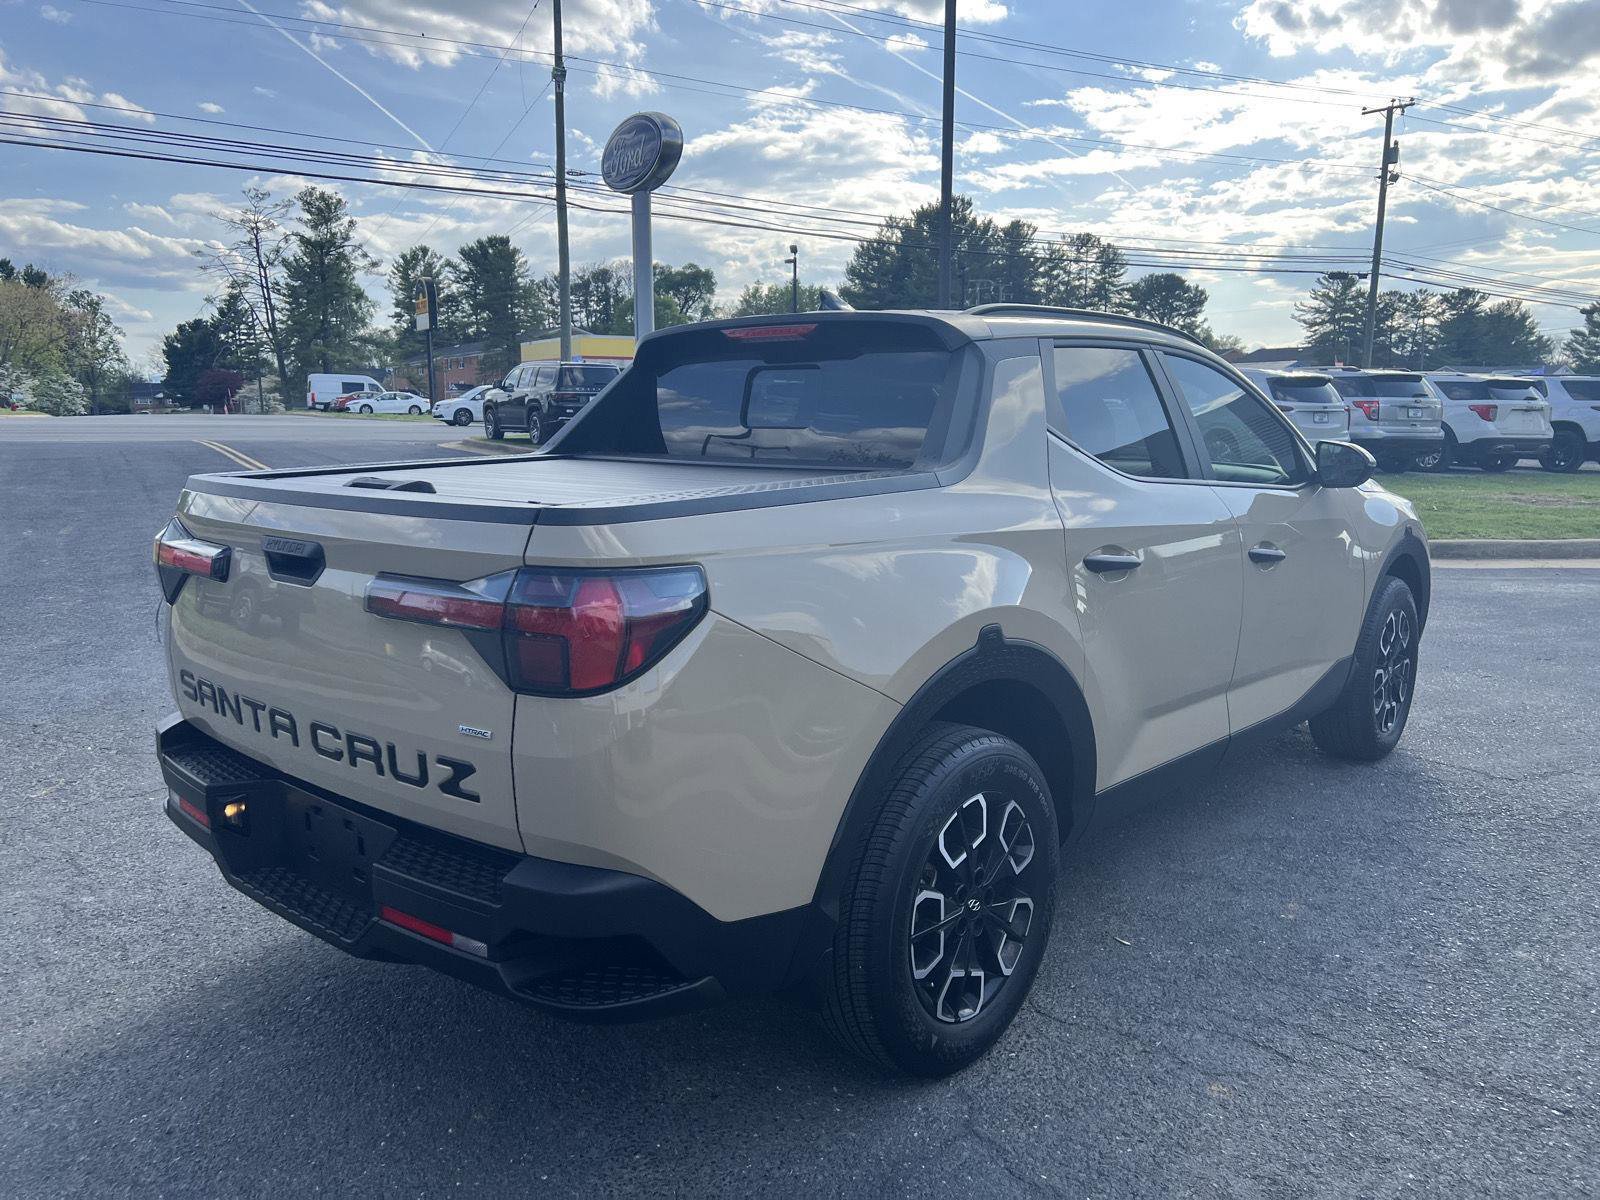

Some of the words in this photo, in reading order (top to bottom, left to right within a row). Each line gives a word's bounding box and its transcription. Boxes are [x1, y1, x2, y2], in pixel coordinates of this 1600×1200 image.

[604, 128, 648, 178] Ford
[179, 668, 300, 748] SANTA
[310, 719, 481, 804] CRUZ
[460, 727, 490, 738] HTRAC
